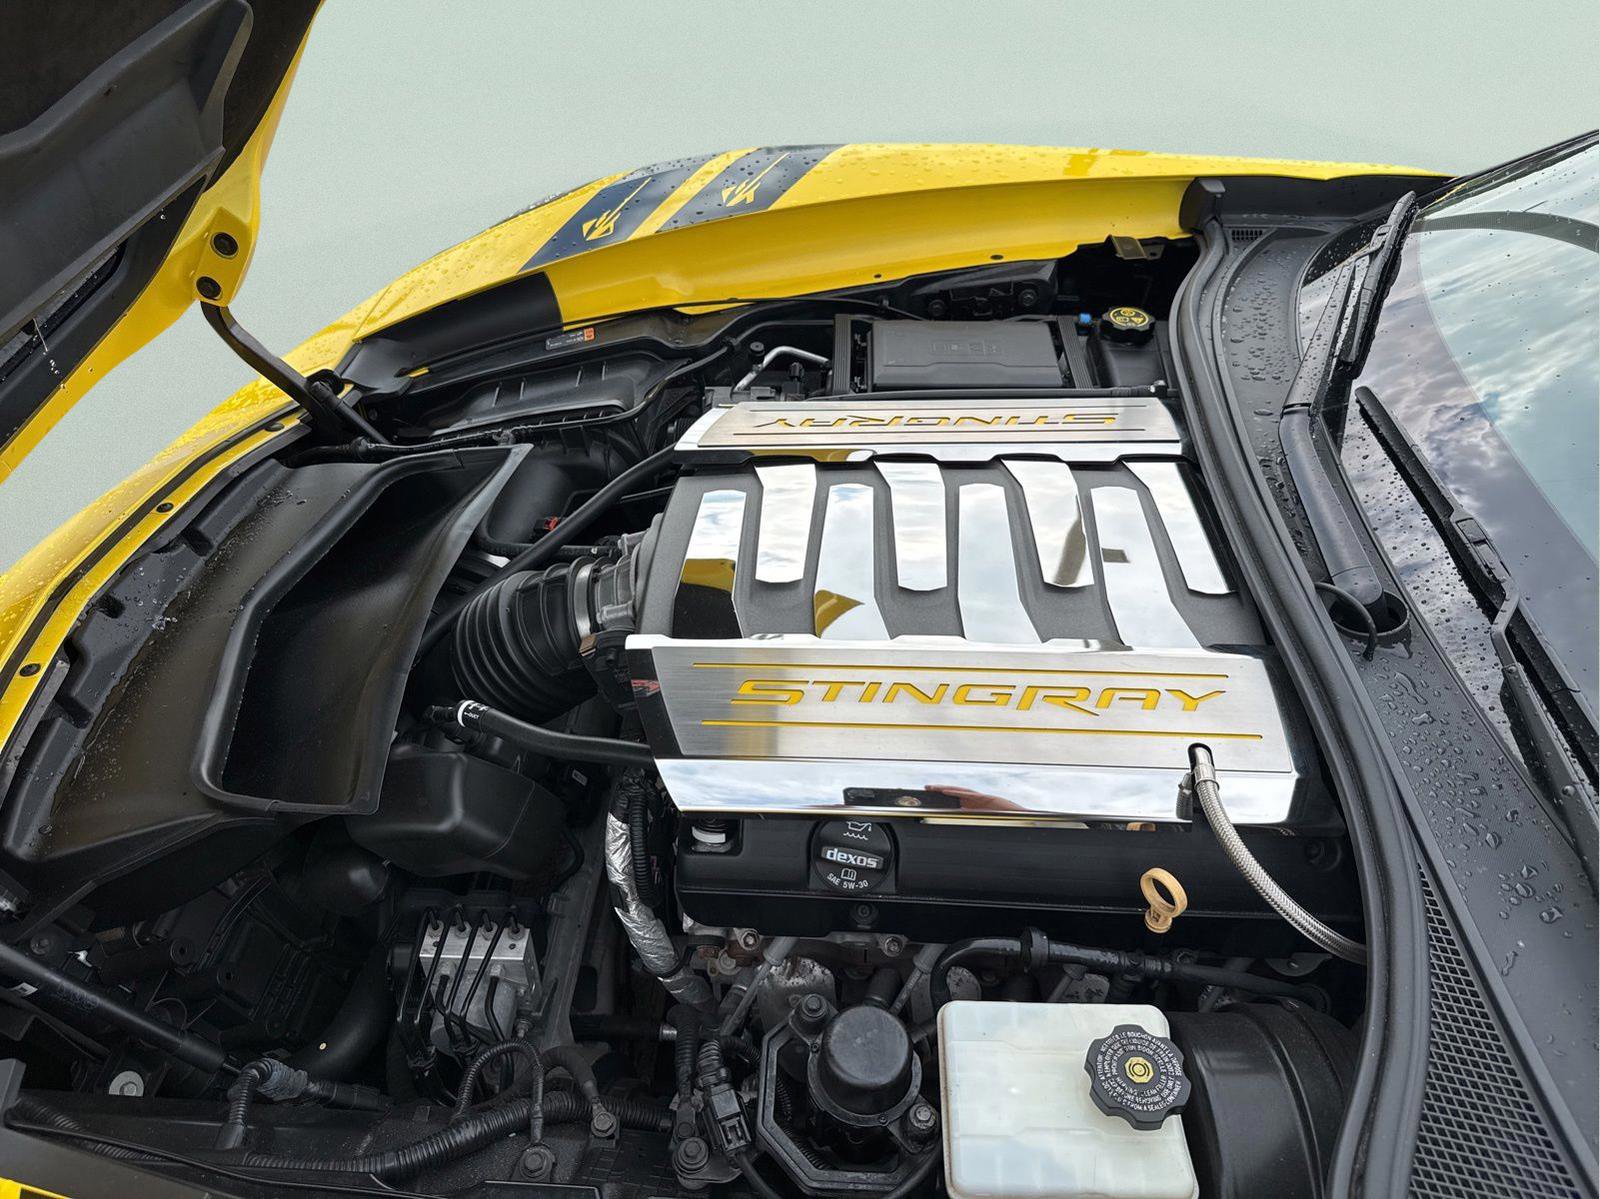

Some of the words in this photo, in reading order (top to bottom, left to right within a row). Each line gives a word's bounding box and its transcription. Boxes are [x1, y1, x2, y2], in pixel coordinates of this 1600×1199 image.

[754, 413, 1119, 428] STINGRAY
[730, 679, 1226, 716] STINGRAY
[826, 848, 878, 869] dexos
[826, 873, 841, 886] SAE
[842, 879, 869, 889] 5W-30
